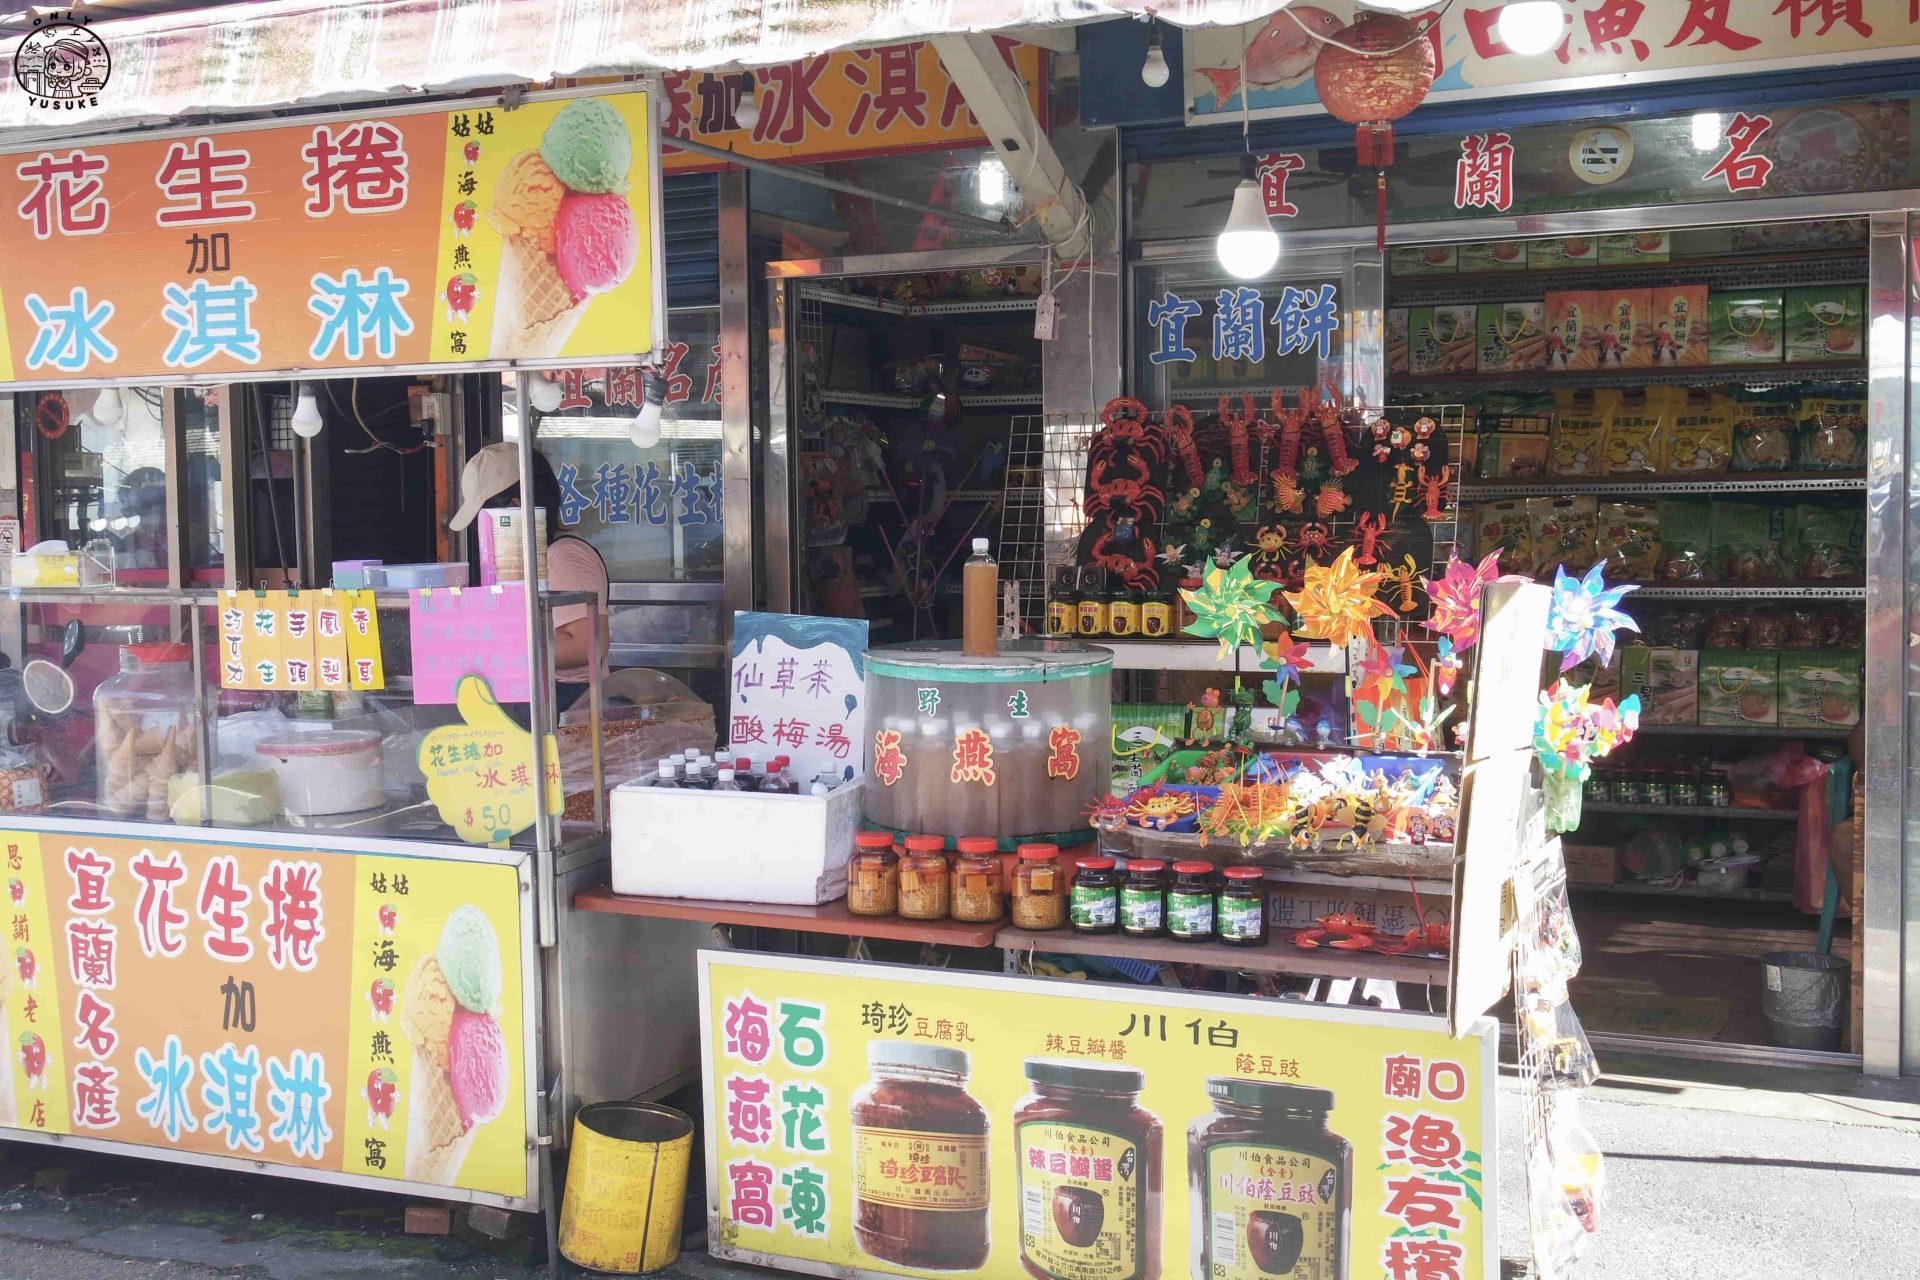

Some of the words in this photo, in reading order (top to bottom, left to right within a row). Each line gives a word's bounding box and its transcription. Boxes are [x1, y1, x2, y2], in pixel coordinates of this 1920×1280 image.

[452, 111, 495, 137] 姑姑
[18, 122, 408, 238] 花生捲
[185, 233, 231, 274] 加
[450, 171, 478, 355] 海燕窩
[25, 267, 412, 368] 冰淇淋
[1148, 284, 1339, 364] 宜蘭餅
[733, 656, 834, 700] 仙草茶
[918, 687, 1029, 718] 野生
[731, 714, 851, 759] 酸梅湯
[875, 727, 1082, 786] 海燕窩
[370, 872, 410, 896] 姑姑
[132, 851, 322, 969] 花生捲
[66, 850, 118, 1126] 宜蘭名產
[220, 975, 256, 1033] 加
[1045, 1032, 1128, 1060] 辣豆瓣醬
[1118, 1013, 1239, 1048] 川伯
[364, 940, 400, 1171] 海燕窩
[1235, 1053, 1301, 1079] 蔭豆豉
[1385, 1054, 1465, 1101] 廟口
[137, 1039, 329, 1155] 冰淇淋
[725, 996, 773, 1228] 海燕窩
[779, 1002, 827, 1234] 石花凍
[1044, 1129, 1110, 1148] 川伯食品公司
[1239, 1151, 1311, 1169] 川伯食品公司
[879, 1158, 965, 1190] 琦珍豆腐乳
[1029, 1147, 1113, 1182] 辣豆瓣醬
[1219, 1174, 1317, 1205] 川伯蔭豆豉
